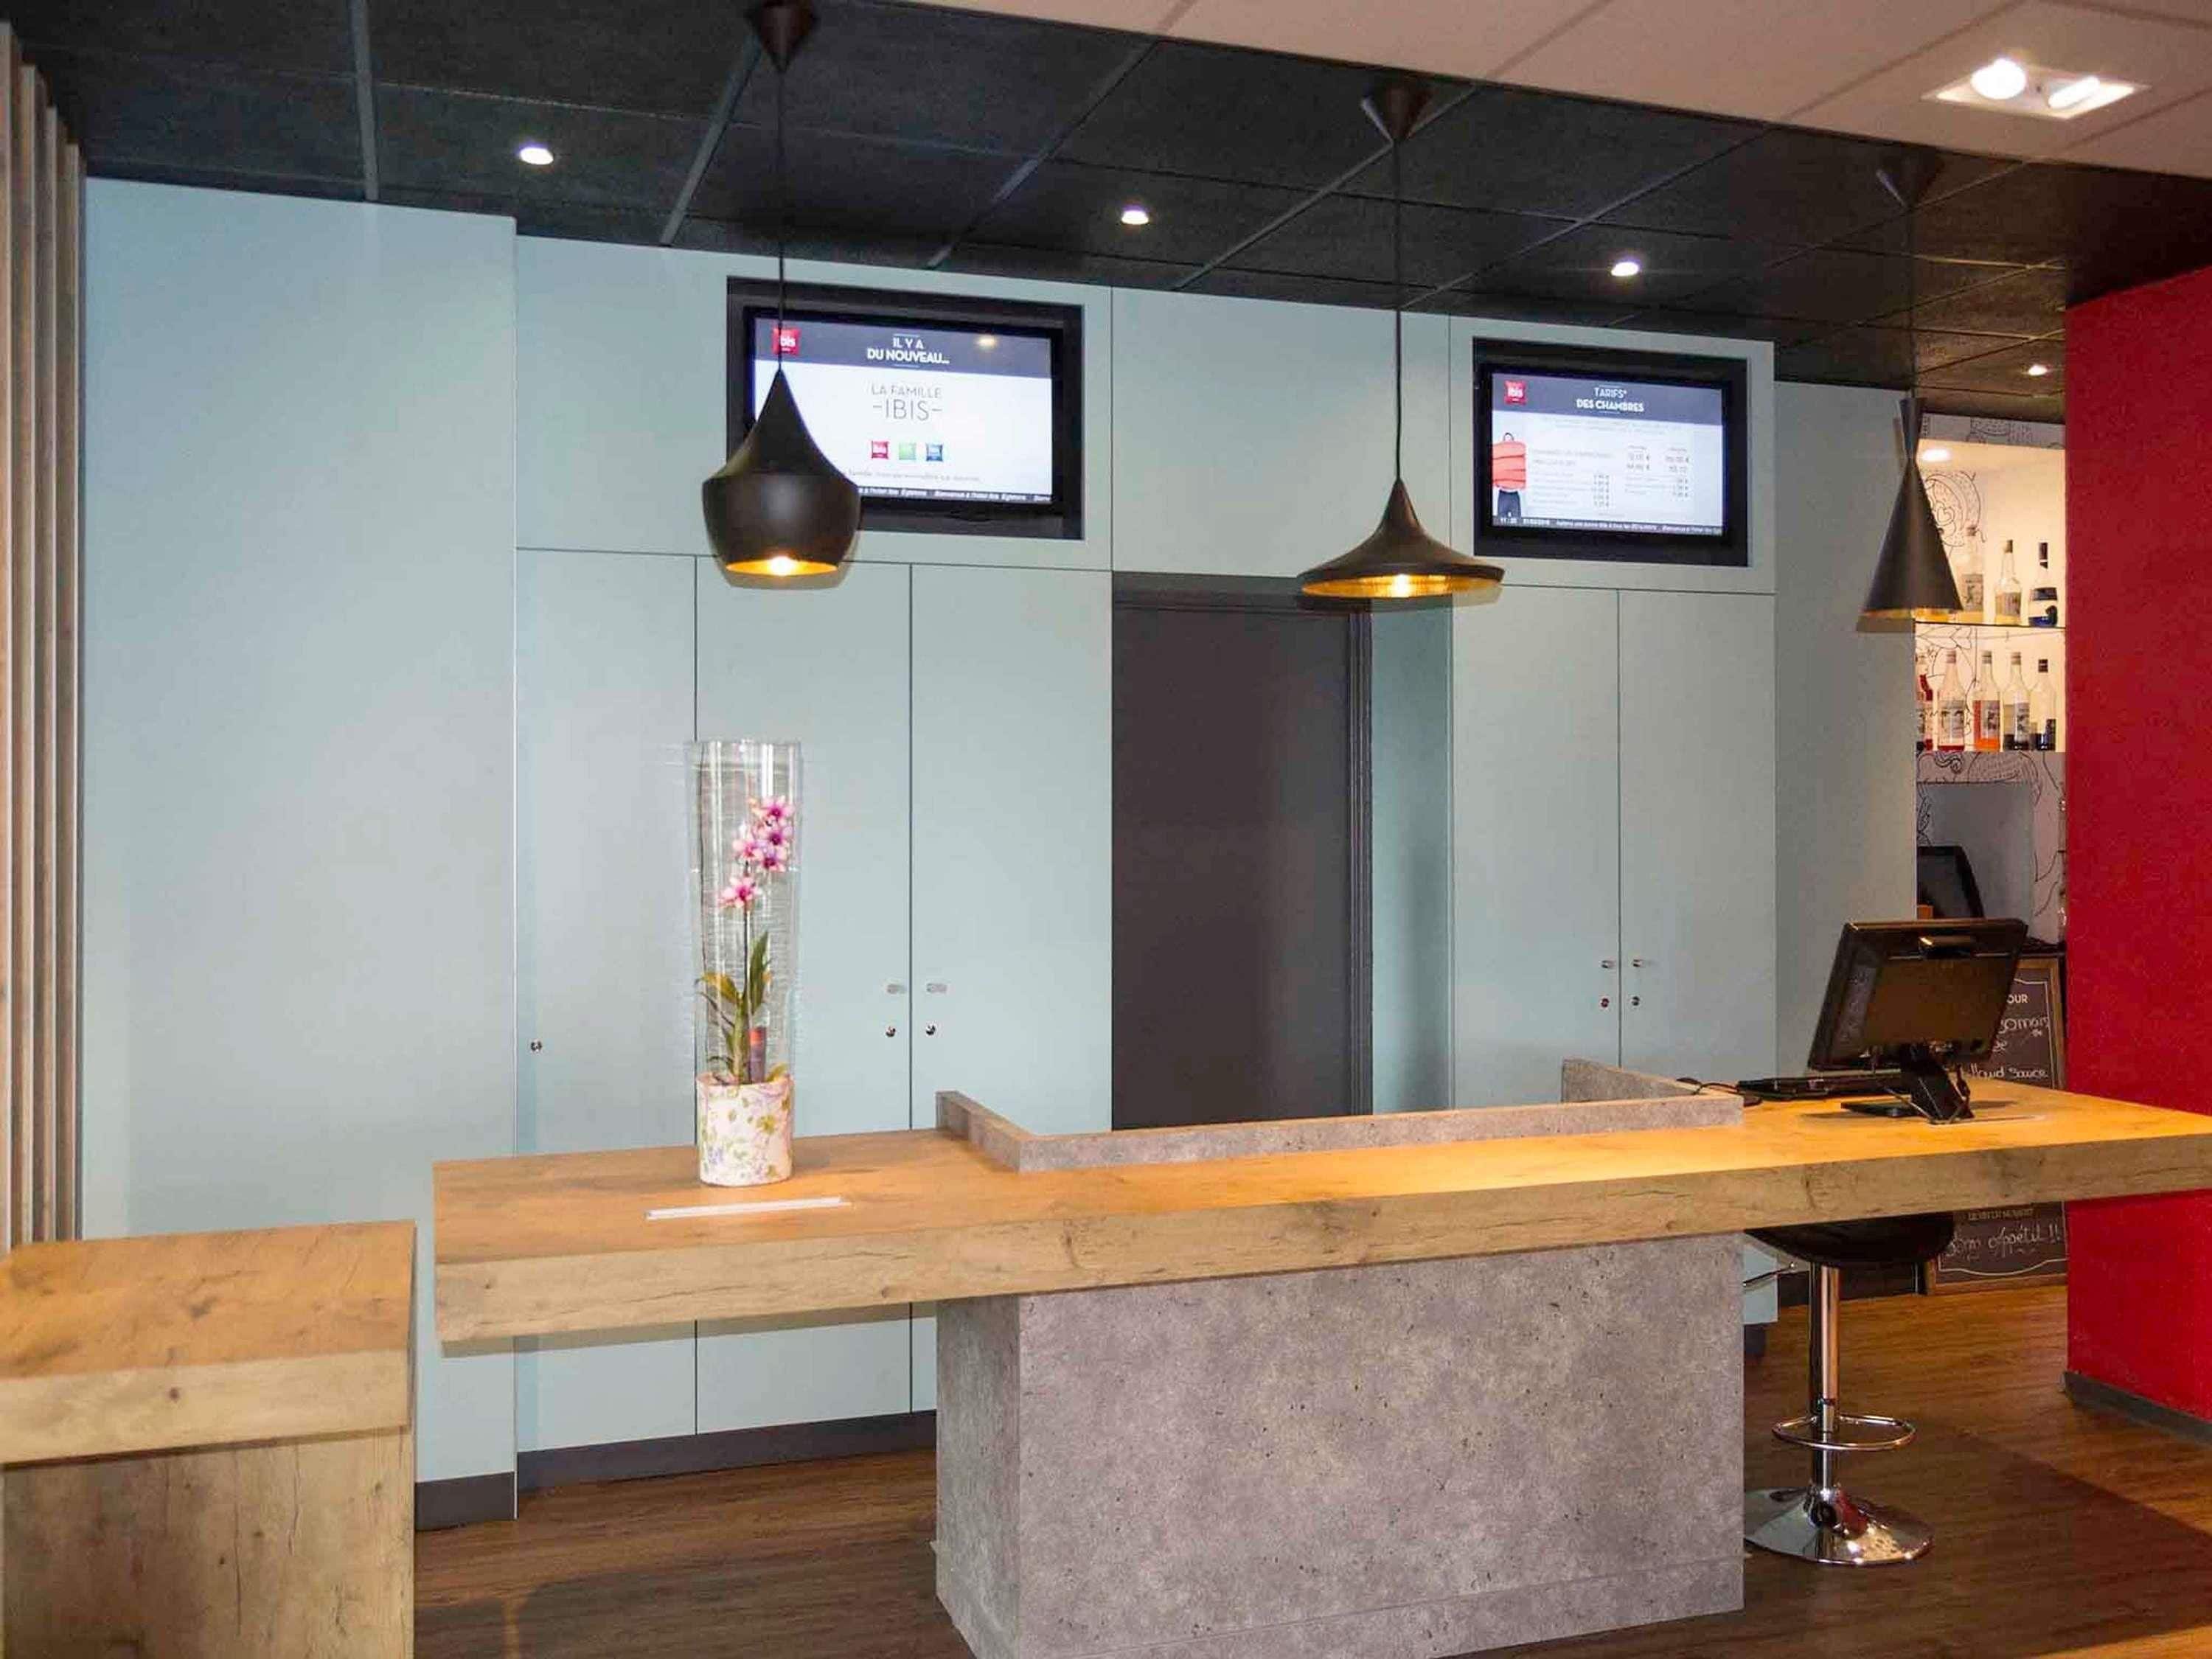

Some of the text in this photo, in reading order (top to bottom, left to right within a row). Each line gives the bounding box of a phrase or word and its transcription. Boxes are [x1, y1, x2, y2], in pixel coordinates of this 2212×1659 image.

[892, 337, 925, 349] IL Y A
[867, 348, 884, 360] DU
[871, 383, 942, 399] LA FAMILLE
[1576, 398, 1644, 413] DES CHAMBRES
[2006, 993, 2029, 1004] OUR
